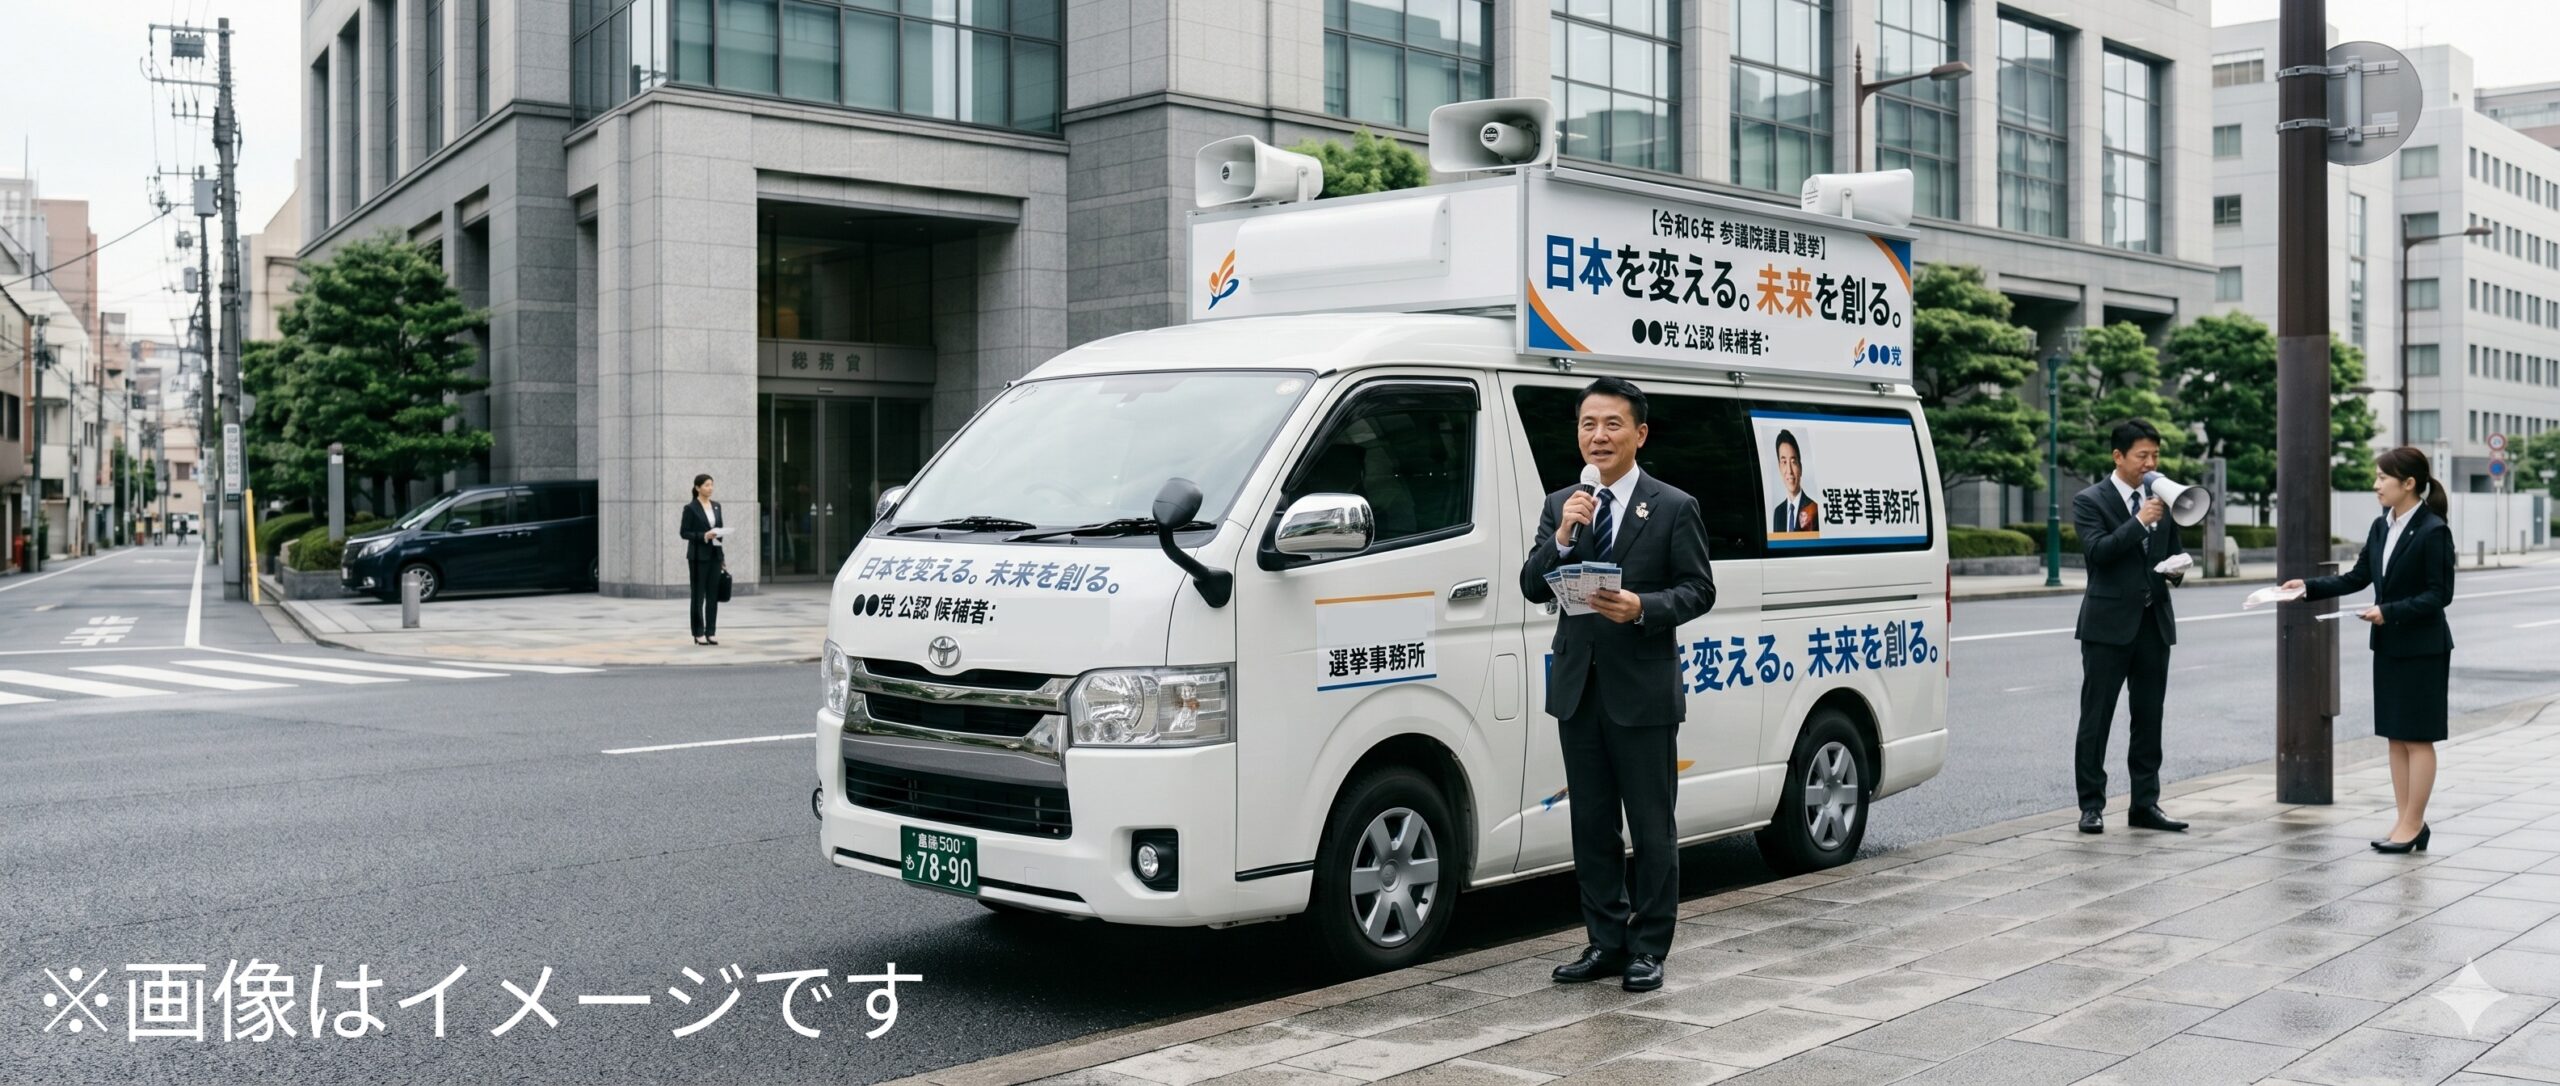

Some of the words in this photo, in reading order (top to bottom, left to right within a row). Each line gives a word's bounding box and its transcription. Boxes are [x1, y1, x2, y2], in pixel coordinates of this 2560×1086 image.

[1718, 221, 1791, 256] 参議院議員
[1684, 324, 1715, 351] 公認
[1822, 488, 1920, 525] 選挙事務所
[898, 595, 932, 620] 公認
[1328, 641, 1426, 678] 選挙事務所
[917, 850, 972, 888] 78-90
